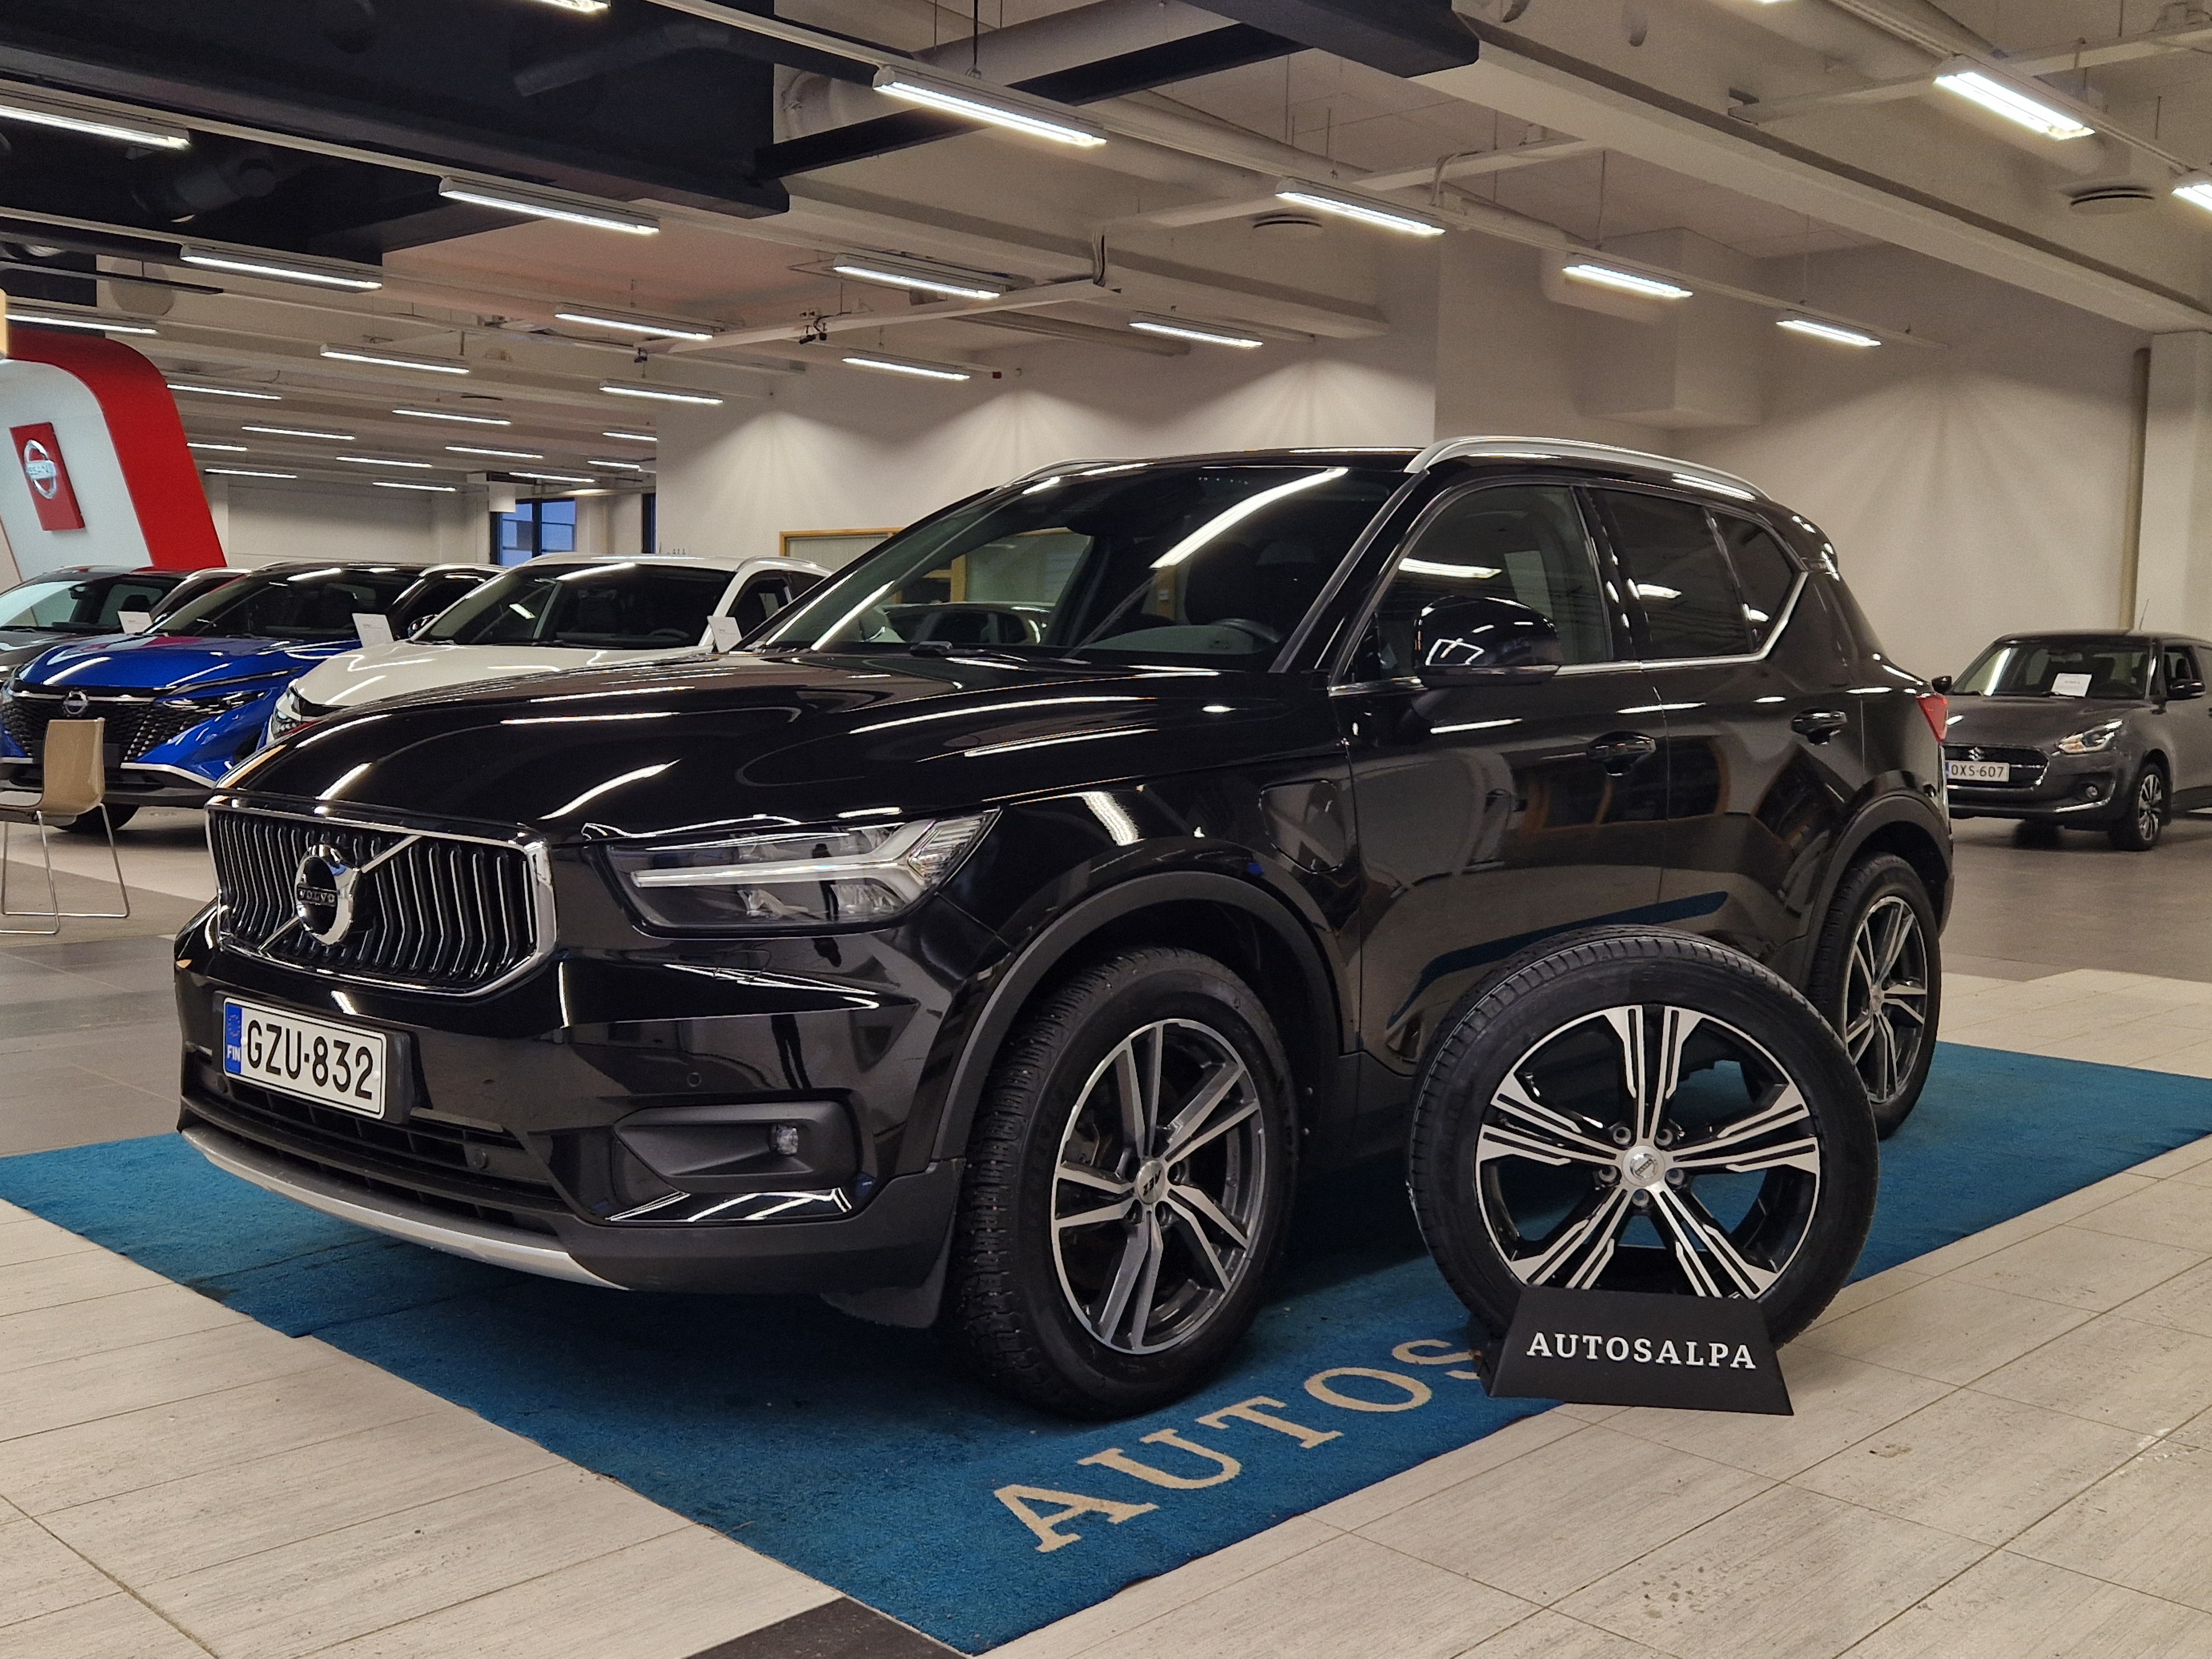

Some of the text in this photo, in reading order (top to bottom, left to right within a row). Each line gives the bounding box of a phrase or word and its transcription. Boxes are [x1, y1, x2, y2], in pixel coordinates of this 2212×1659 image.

[1951, 764, 2004, 778] OXS-607
[299, 889, 335, 903] VOLVO
[227, 1045, 241, 1062] FIN
[247, 1020, 373, 1100] GZU-832
[1526, 1332, 1756, 1369] AUTOSALPA
